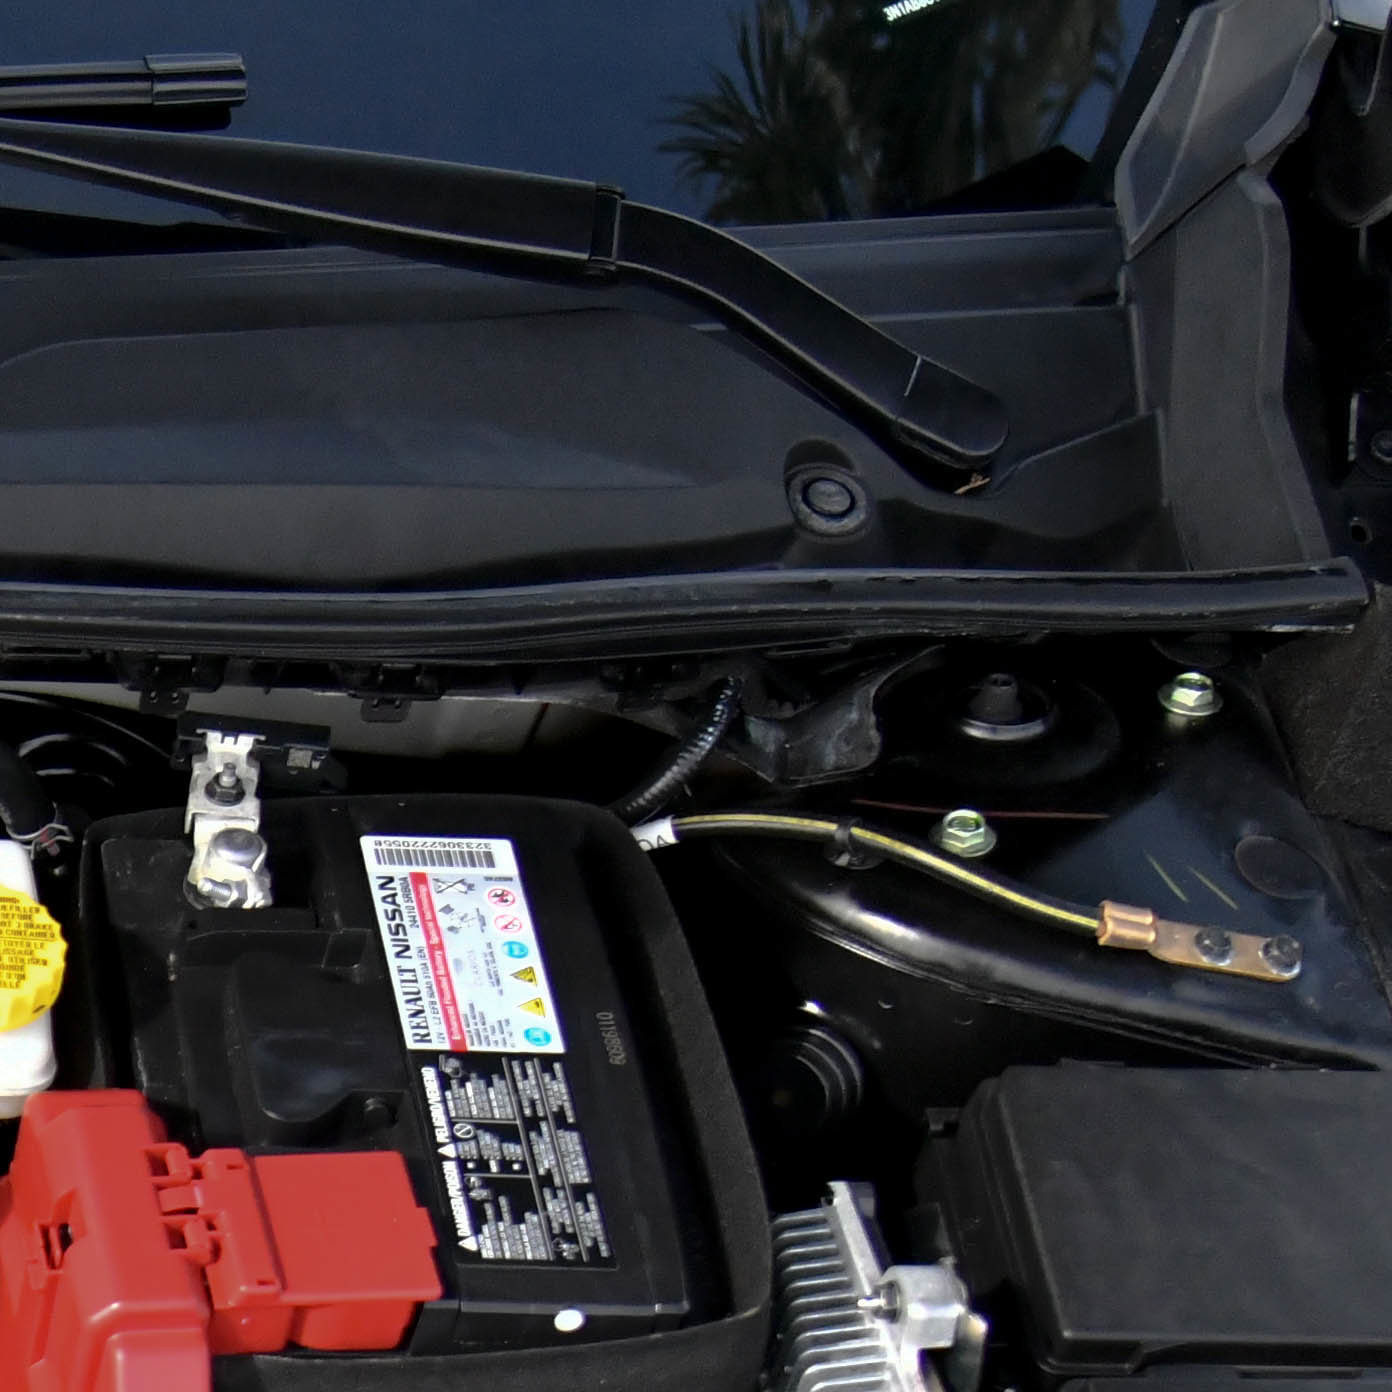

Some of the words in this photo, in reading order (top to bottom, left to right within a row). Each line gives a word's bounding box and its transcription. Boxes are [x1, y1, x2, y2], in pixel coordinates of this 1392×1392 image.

[375, 875, 412, 958] NISSAN
[396, 965, 433, 1043] RENAULT
[441, 1160, 472, 1236] DANGER/POISON
